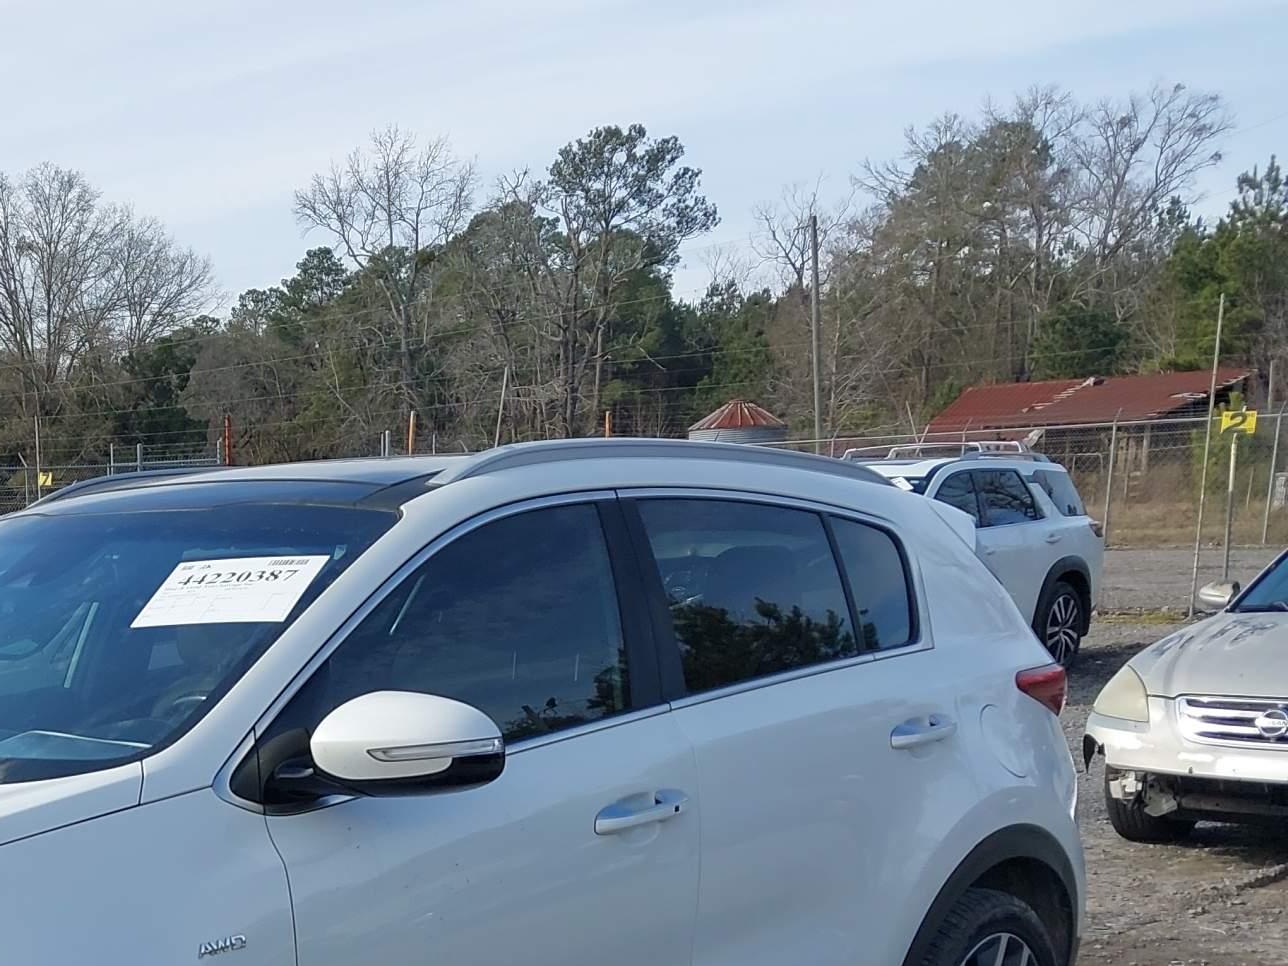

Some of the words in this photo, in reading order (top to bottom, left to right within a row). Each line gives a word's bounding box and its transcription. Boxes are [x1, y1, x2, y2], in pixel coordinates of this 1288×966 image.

[1223, 411, 1248, 432] 2
[177, 569, 300, 585] 44220387
[198, 935, 247, 960] AWD
